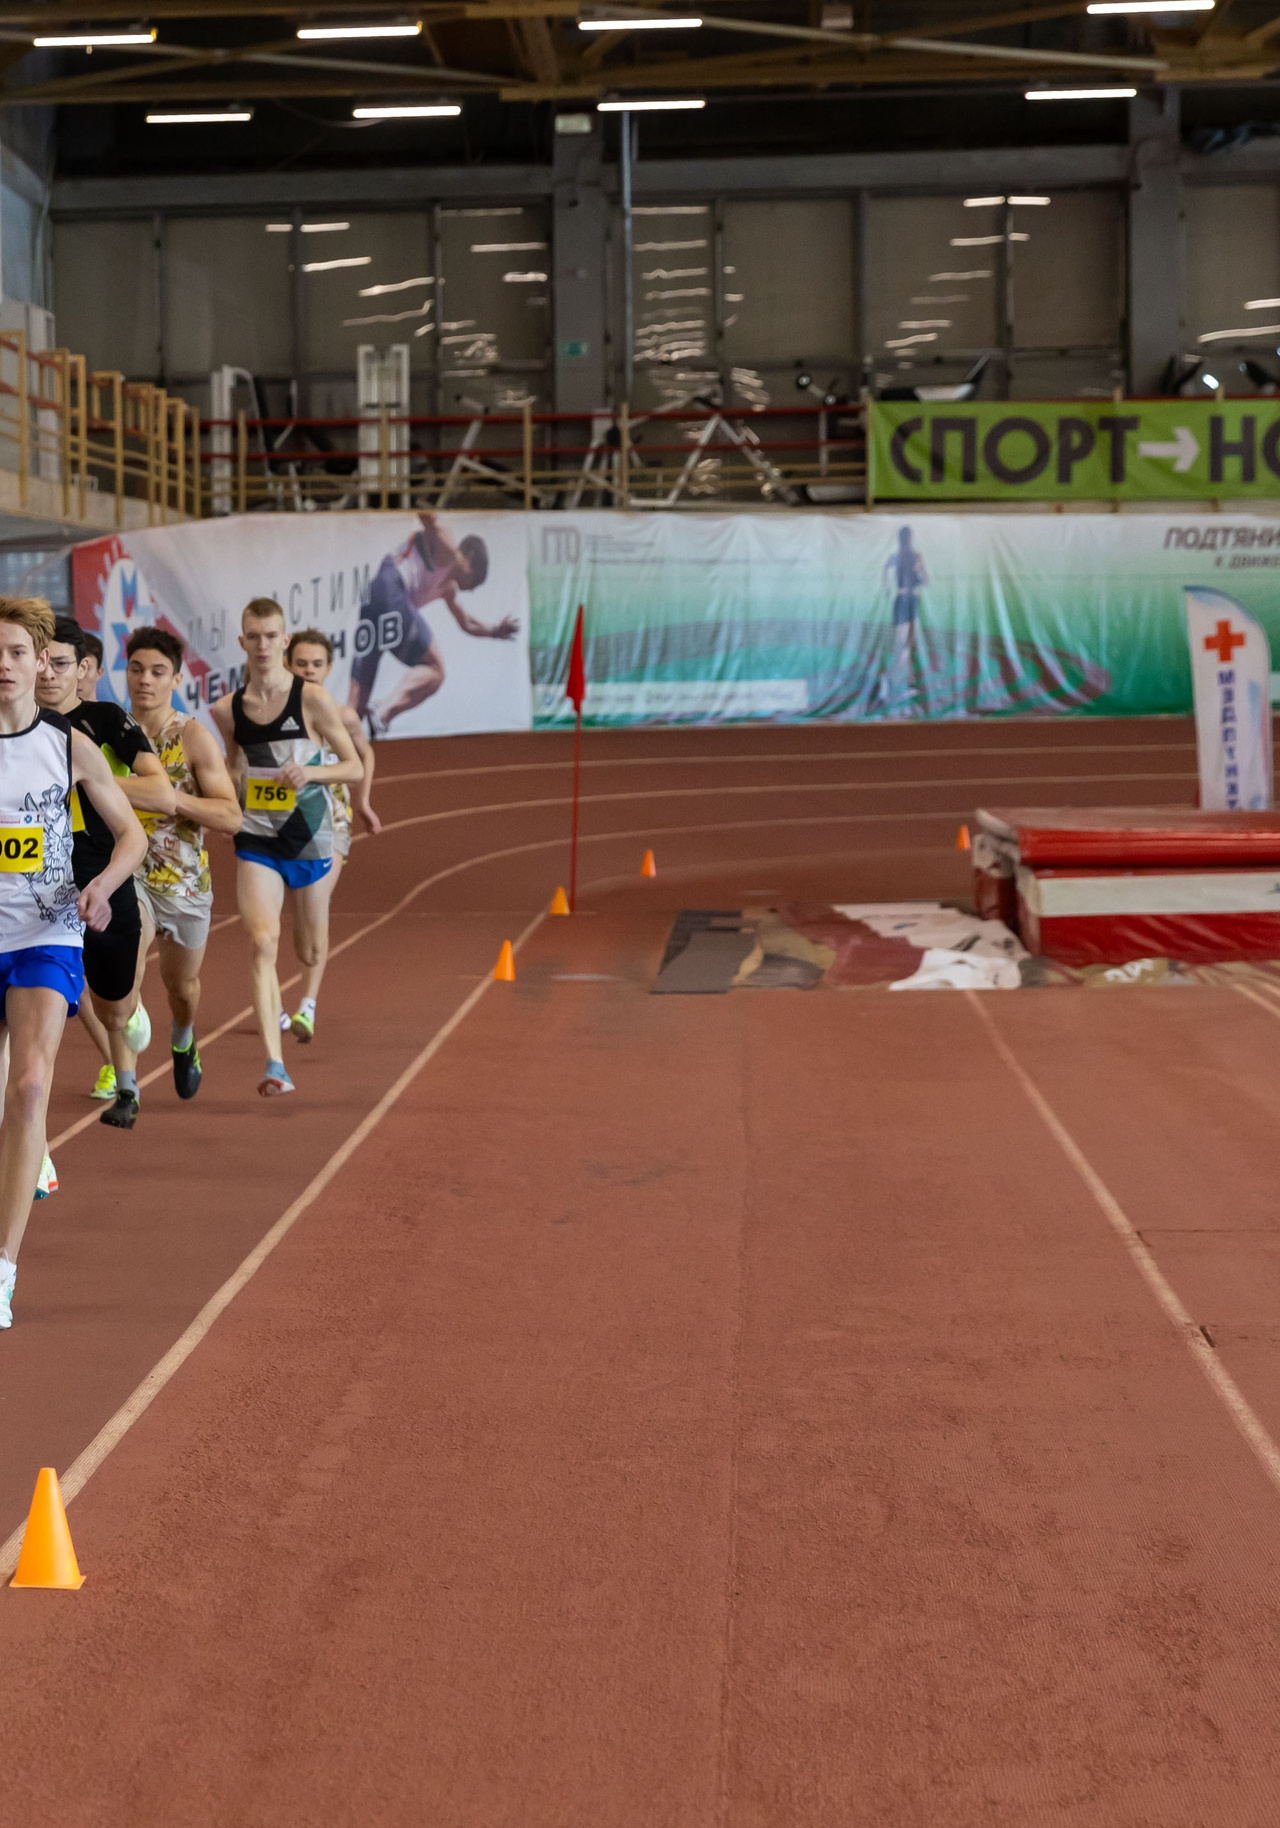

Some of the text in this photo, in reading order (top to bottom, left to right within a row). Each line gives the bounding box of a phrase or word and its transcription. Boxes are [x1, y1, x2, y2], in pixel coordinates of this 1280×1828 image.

[890, 415, 1280, 485] СПОРТ Н
[251, 562, 371, 627] СТИМ
[254, 785, 288, 802] 756
